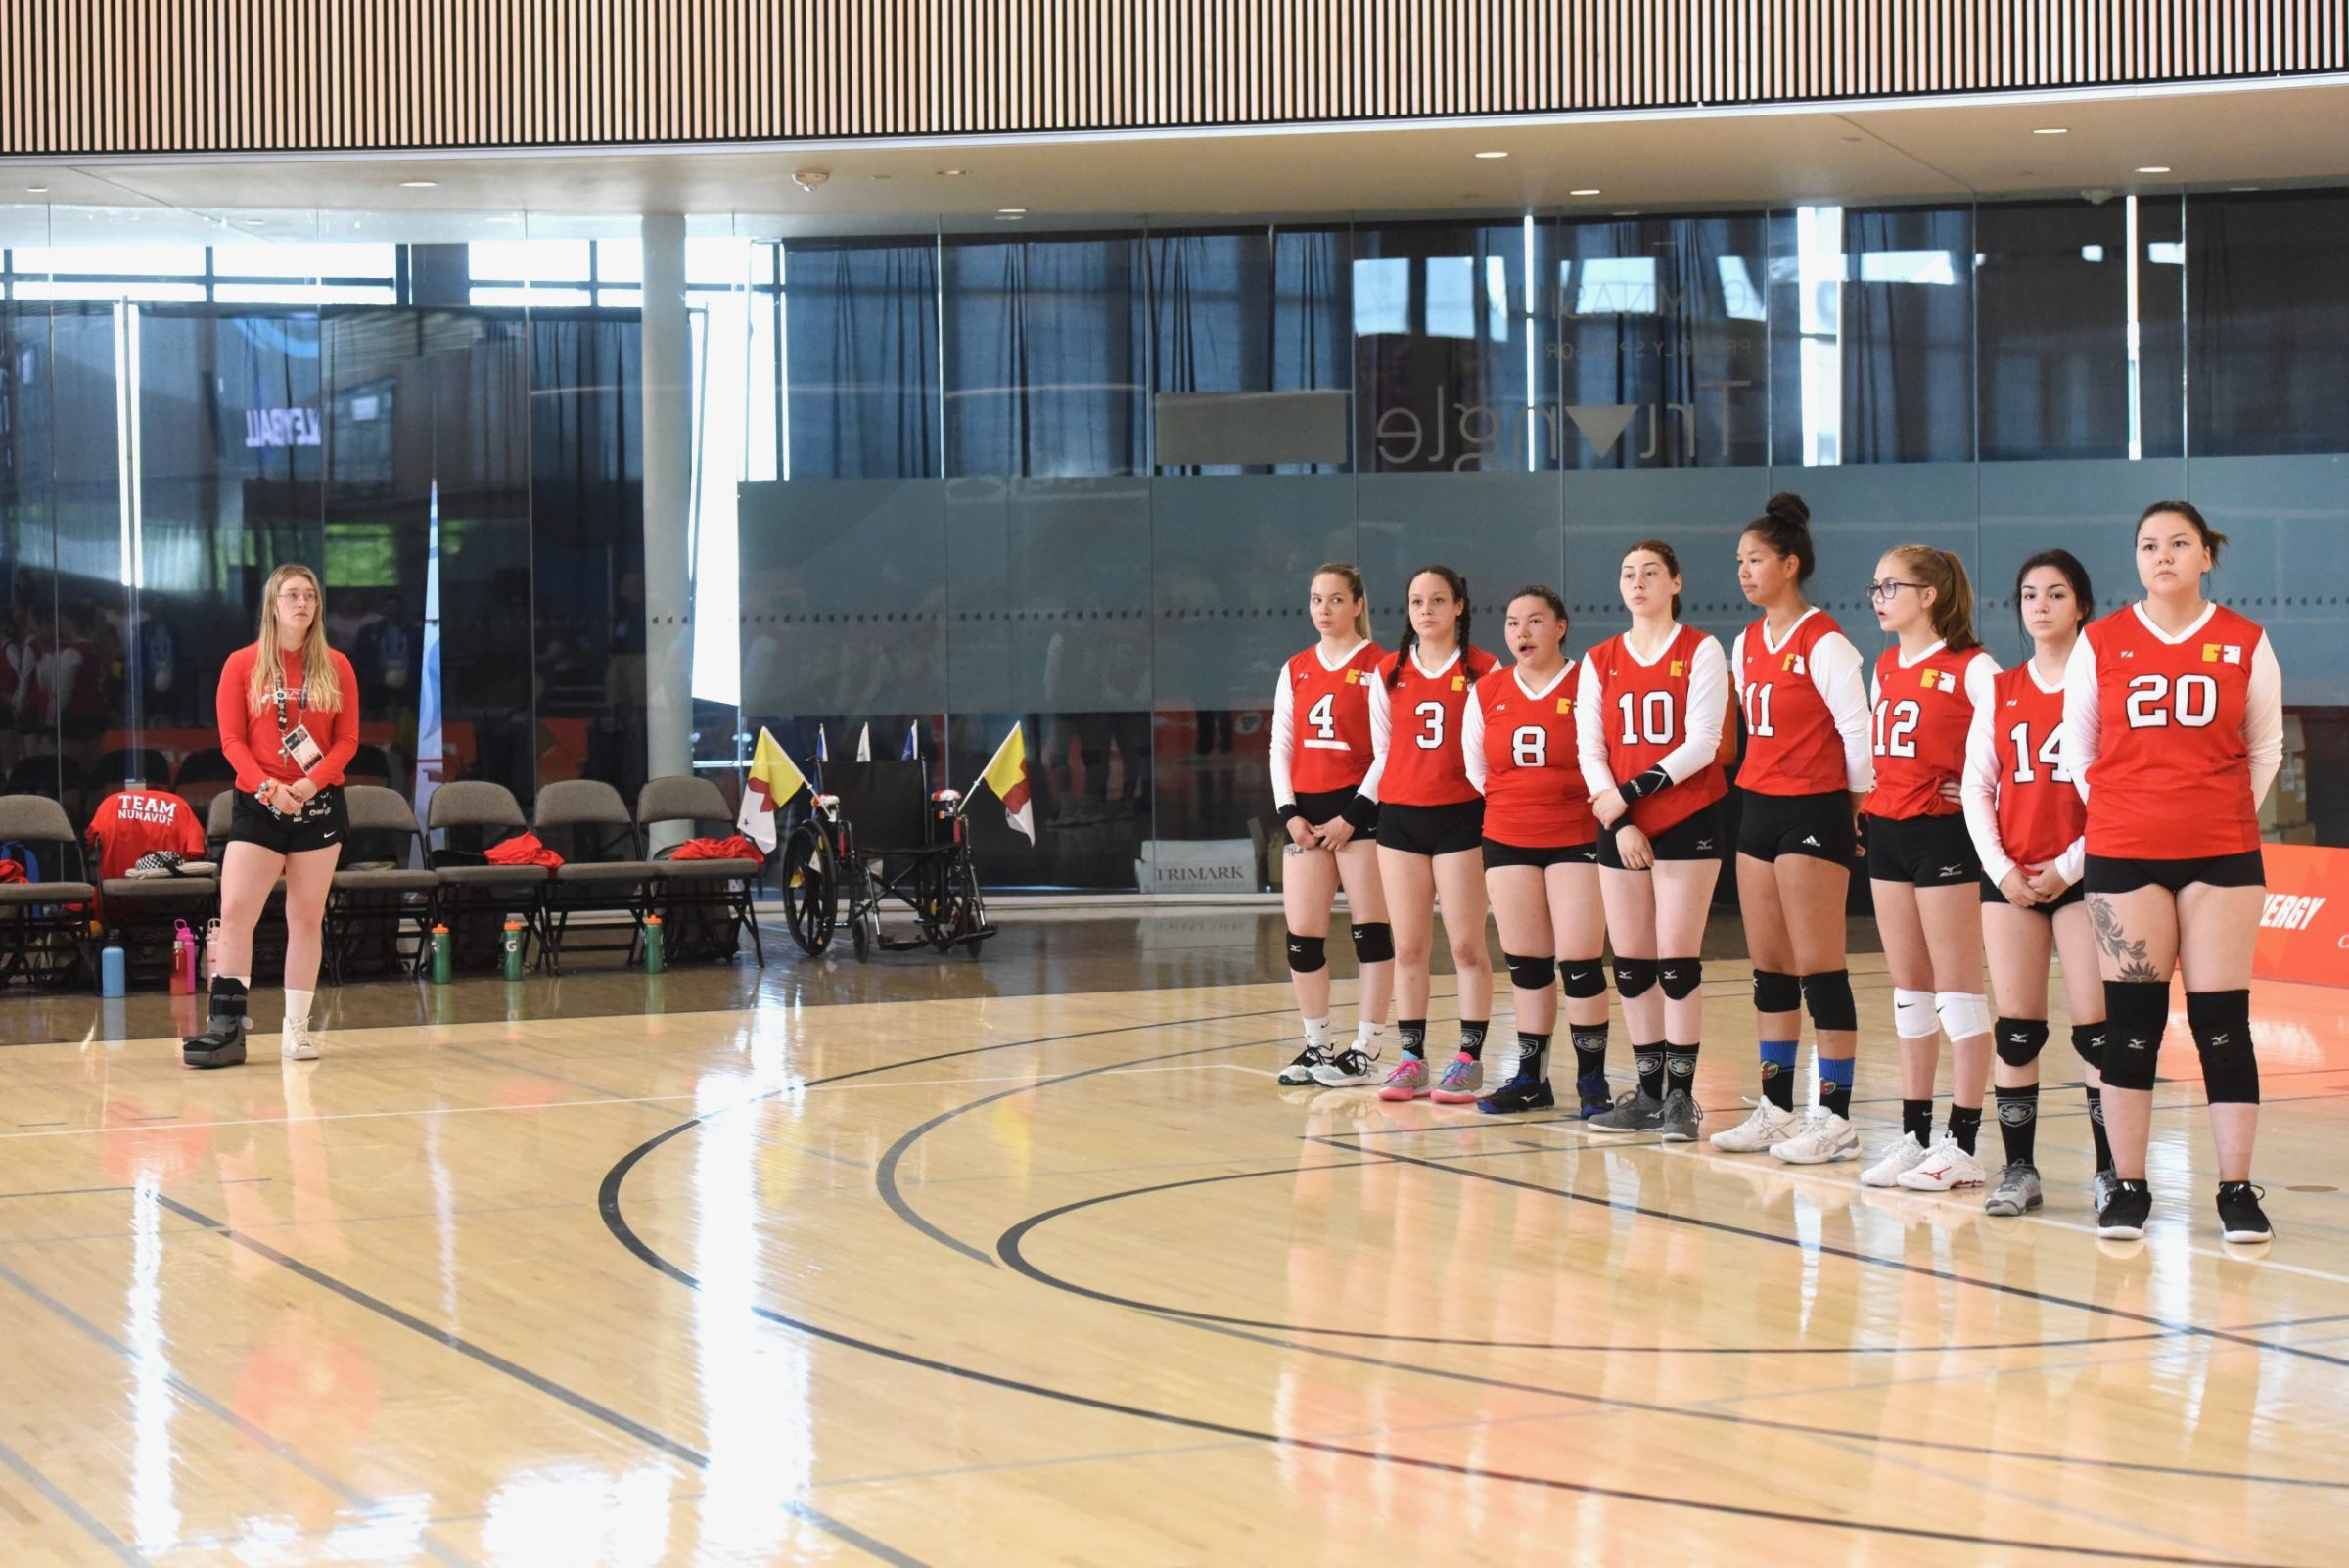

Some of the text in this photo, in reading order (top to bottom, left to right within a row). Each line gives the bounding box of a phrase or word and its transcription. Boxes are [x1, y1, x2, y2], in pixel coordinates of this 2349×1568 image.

[1307, 693, 1336, 740] 4
[1414, 700, 1446, 750] 3
[1617, 690, 1675, 745] 10
[1745, 681, 1775, 737] 11
[2125, 672, 2219, 730] 20
[1512, 724, 1547, 767] 8
[1873, 698, 1922, 759] 12
[2009, 720, 2073, 784] 14
[117, 795, 177, 818] TEAM
[117, 809, 173, 827] NUNAVUT
[1157, 866, 1245, 881] TRIMARK
